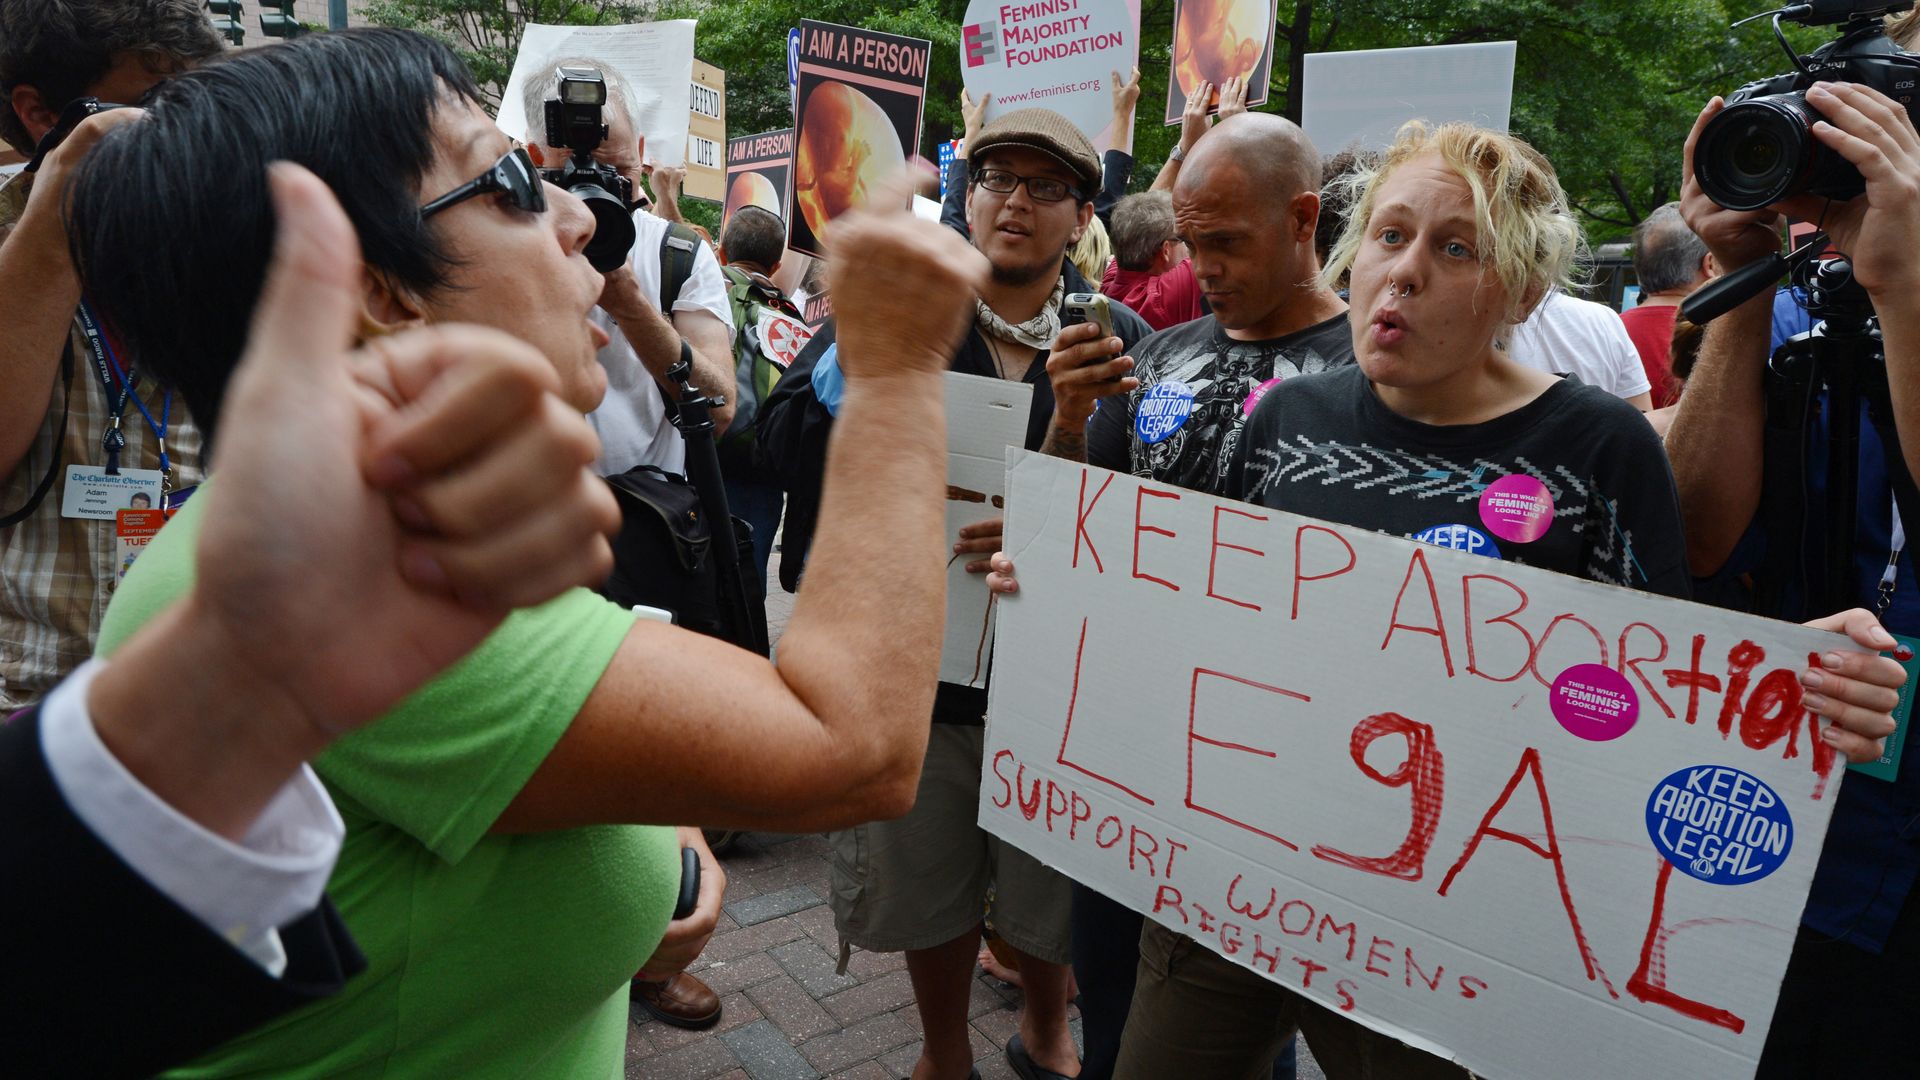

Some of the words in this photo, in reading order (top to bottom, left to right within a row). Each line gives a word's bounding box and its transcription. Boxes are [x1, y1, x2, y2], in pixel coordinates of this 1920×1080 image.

[1000, 0, 1078, 25] FEMINIST
[1003, 15, 1090, 47] MAJORITY
[800, 27, 806, 55] I
[808, 29, 835, 60] AM
[836, 34, 849, 63] A
[853, 37, 926, 79] PERSON
[1005, 31, 1123, 68] FOUNDATION
[997, 79, 1101, 105] www.feminist.org
[1895, 80, 1915, 89] EOS
[690, 83, 719, 118] DEFEND
[697, 138, 713, 166] LIFE
[733, 141, 747, 161] AM
[747, 140, 754, 159] A
[755, 133, 793, 157] PERSON
[1150, 385, 1187, 399] KEEP
[1138, 398, 1192, 418] ABORTION
[1139, 415, 1179, 435] LEGAL
[1488, 498, 1548, 514] FEMINIST
[1519, 493, 1538, 501] WHAT
[78, 507, 113, 516] Newsroom
[1495, 507, 1522, 516] LOOKS
[1522, 510, 1540, 519] LIKE
[1073, 468, 1356, 620] KEEP
[1560, 686, 1631, 712] FEMINIST
[1568, 680, 1585, 690] THIS
[1596, 687, 1619, 698] WHAT
[1566, 699, 1596, 711] LOOKS
[1598, 706, 1619, 717] LIKE
[1686, 768, 1776, 812] KEEP
[1653, 784, 1788, 856] ABORTION
[1658, 817, 1763, 876] LEGAL
[992, 749, 1187, 879] SUPPORT
[1227, 874, 1488, 999] WOMENS
[1152, 885, 1358, 1011] RIGHTS
